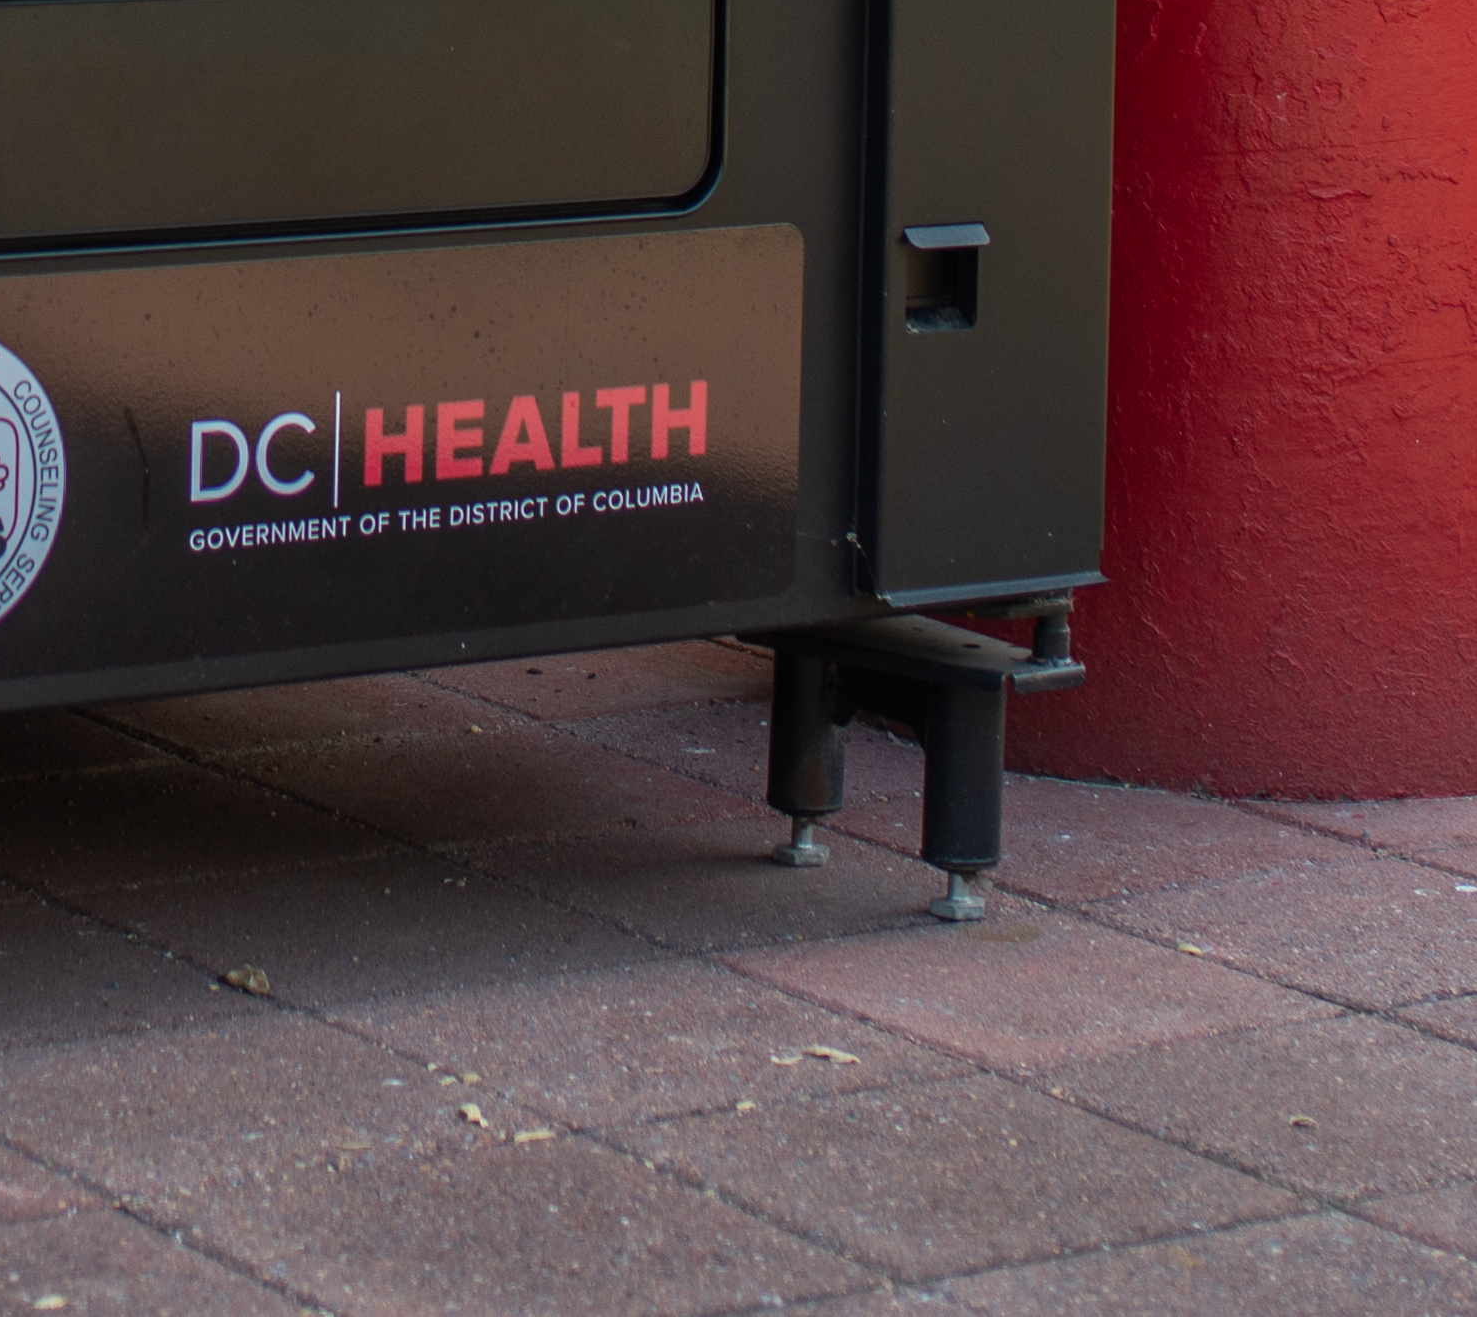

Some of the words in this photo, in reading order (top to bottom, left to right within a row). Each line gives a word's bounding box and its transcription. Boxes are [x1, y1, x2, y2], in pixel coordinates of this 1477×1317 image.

[13, 379, 60, 543] COUNSELING
[189, 411, 317, 503] DC
[363, 379, 708, 488] HEALTH
[188, 516, 350, 552] GOVERNMENT
[359, 512, 391, 535] OF
[398, 506, 442, 531] THE
[449, 497, 548, 527] DISTRICT
[556, 493, 586, 516] OF
[593, 481, 705, 513] COLUMBIA
